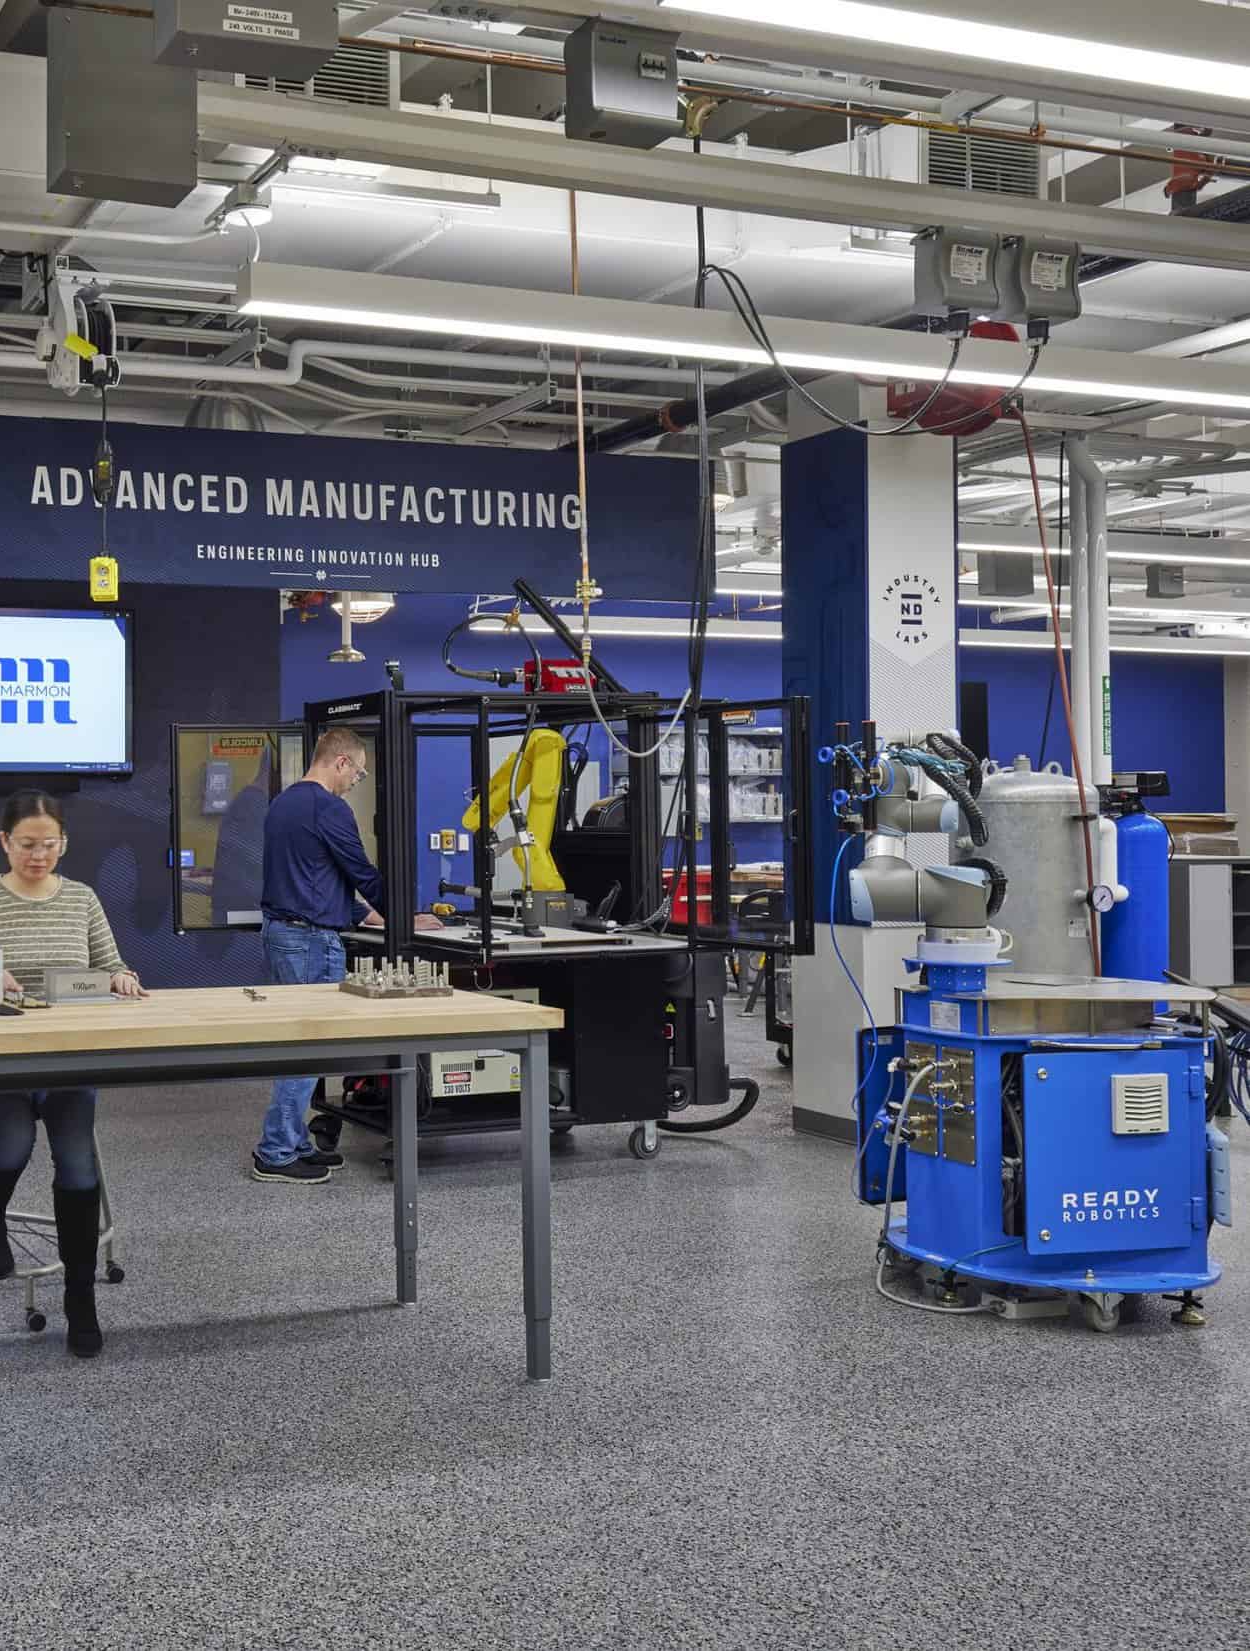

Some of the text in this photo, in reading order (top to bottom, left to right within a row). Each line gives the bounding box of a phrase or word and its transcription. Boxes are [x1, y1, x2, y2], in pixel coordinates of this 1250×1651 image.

[266, 478, 582, 530] MANUFACTURING
[197, 545, 440, 568] ENGINEERING INNOVATION HUB
[882, 574, 940, 603] INDUSTRY
[901, 603, 922, 615] ND
[895, 631, 928, 643] LABS
[0, 684, 71, 697] MARMON
[456, 1084, 471, 1094] VOLTS
[1062, 1188, 1159, 1208] READY
[1062, 1206, 1159, 1223] ROBOTICS
